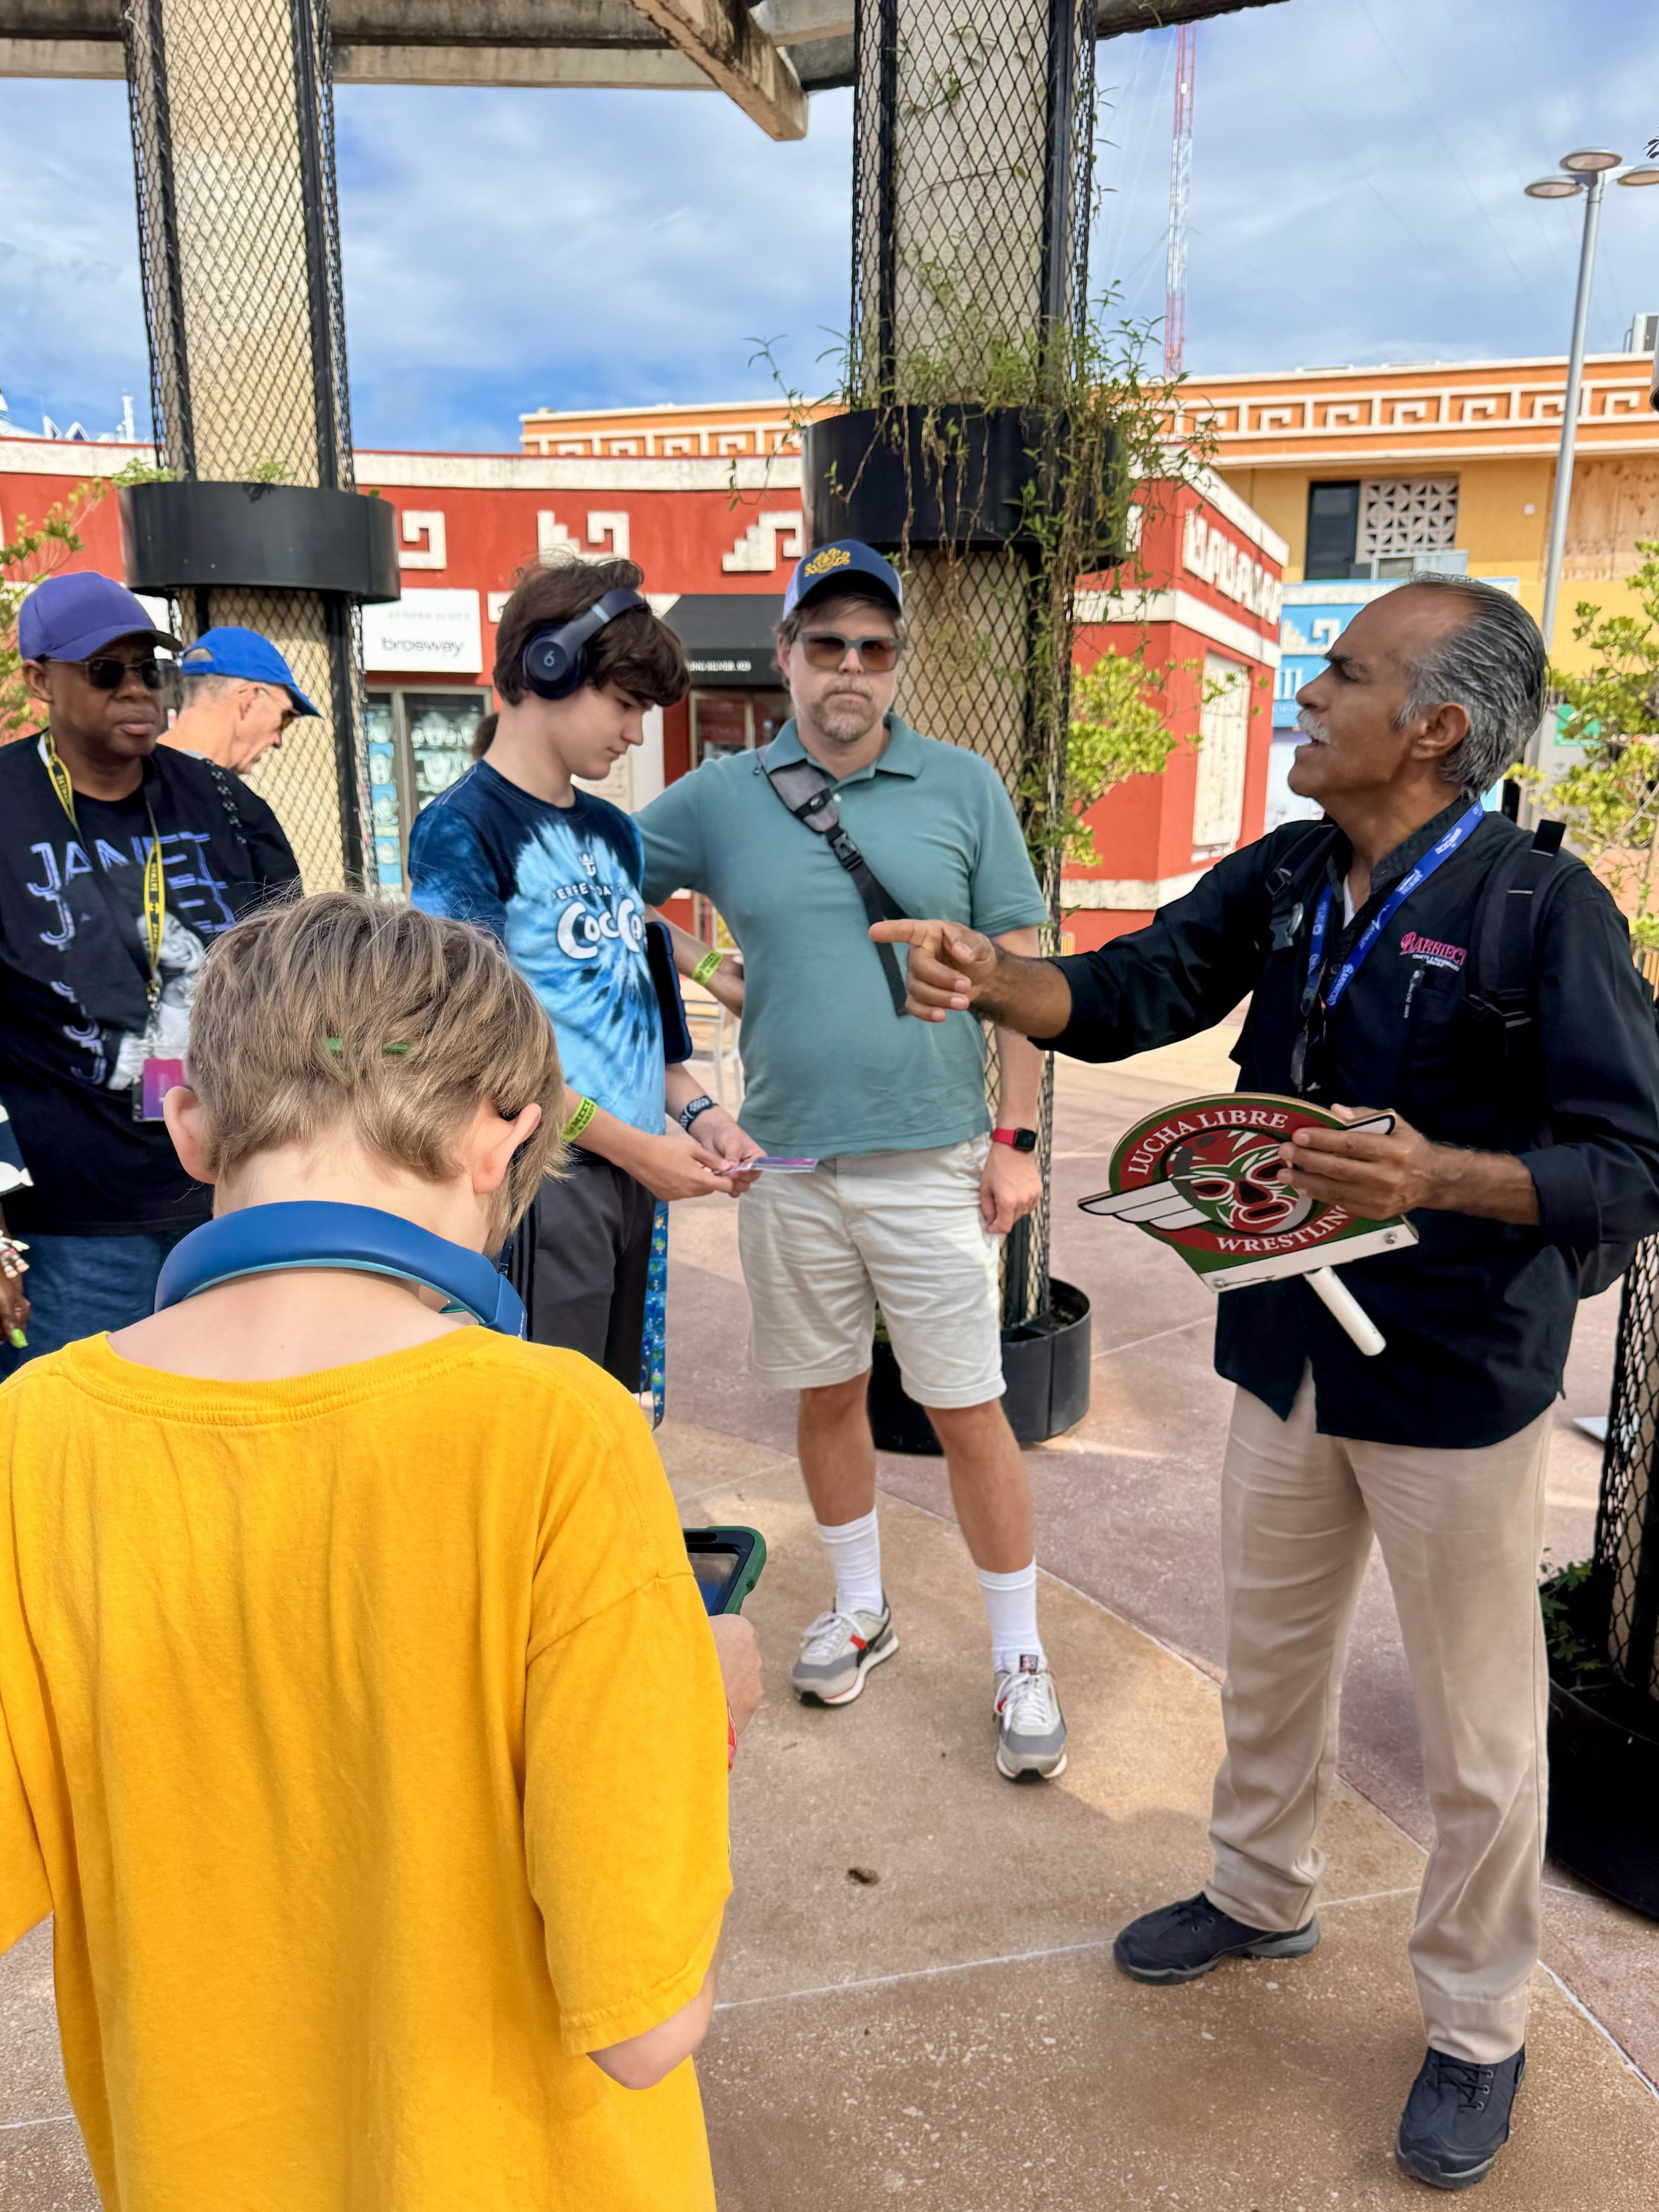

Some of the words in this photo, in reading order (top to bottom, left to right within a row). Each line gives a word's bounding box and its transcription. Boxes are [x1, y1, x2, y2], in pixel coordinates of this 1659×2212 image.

[380, 635, 465, 657] brosway
[1127, 1120, 1198, 1175] LUCHA
[1196, 1109, 1289, 1129] LIBRE
[1216, 1204, 1350, 1252] WRESTLIN
